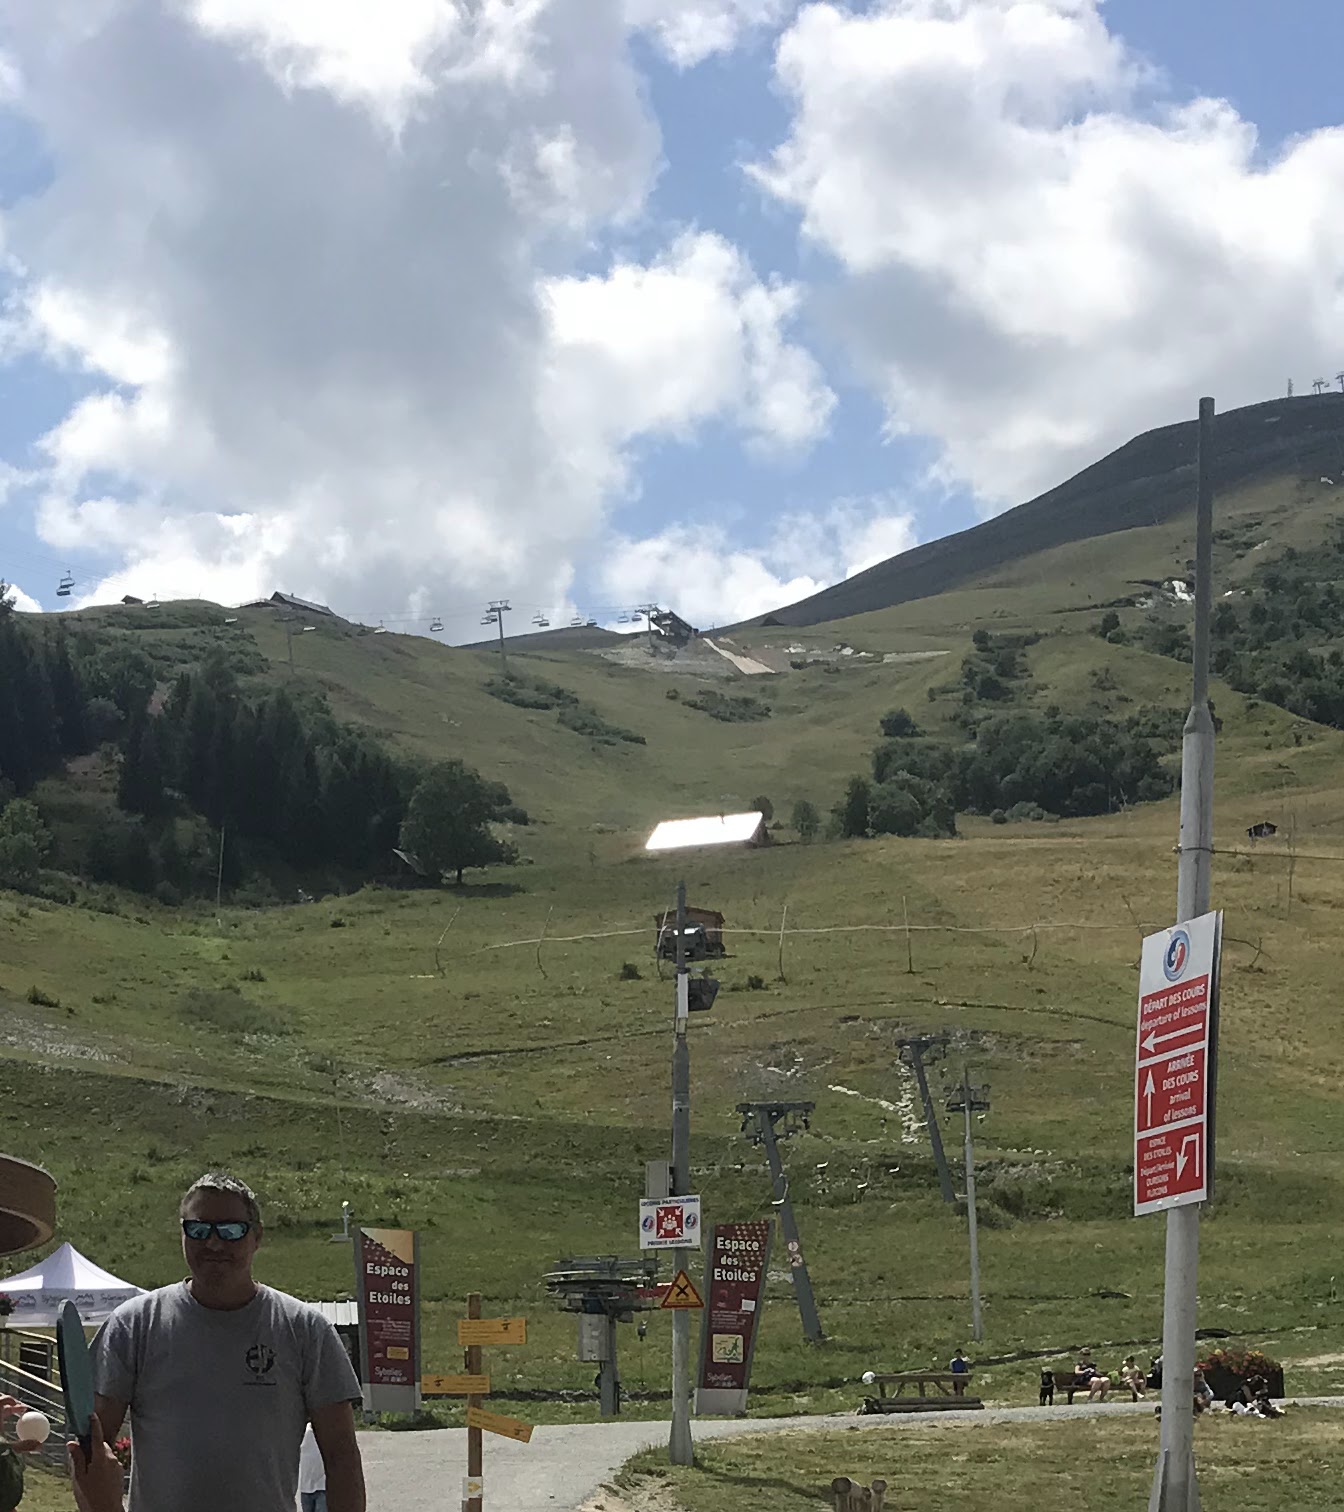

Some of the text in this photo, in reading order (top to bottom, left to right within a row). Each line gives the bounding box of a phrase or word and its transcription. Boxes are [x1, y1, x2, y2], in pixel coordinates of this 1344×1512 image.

[1143, 983, 1205, 1015] DÉPART DES COURS
[1173, 1009, 1181, 1020] of
[1181, 1001, 1207, 1017] lessons
[1162, 1070, 1199, 1090] DES COURS
[1169, 1088, 1191, 1105] arrival
[1163, 1109, 1171, 1122] of
[716, 1237, 759, 1252] Espace
[720, 1256, 738, 1266] des
[366, 1263, 409, 1277] Espace
[714, 1268, 756, 1282] Etoiles
[391, 1280, 409, 1291] des
[369, 1291, 411, 1305] Etoiles
